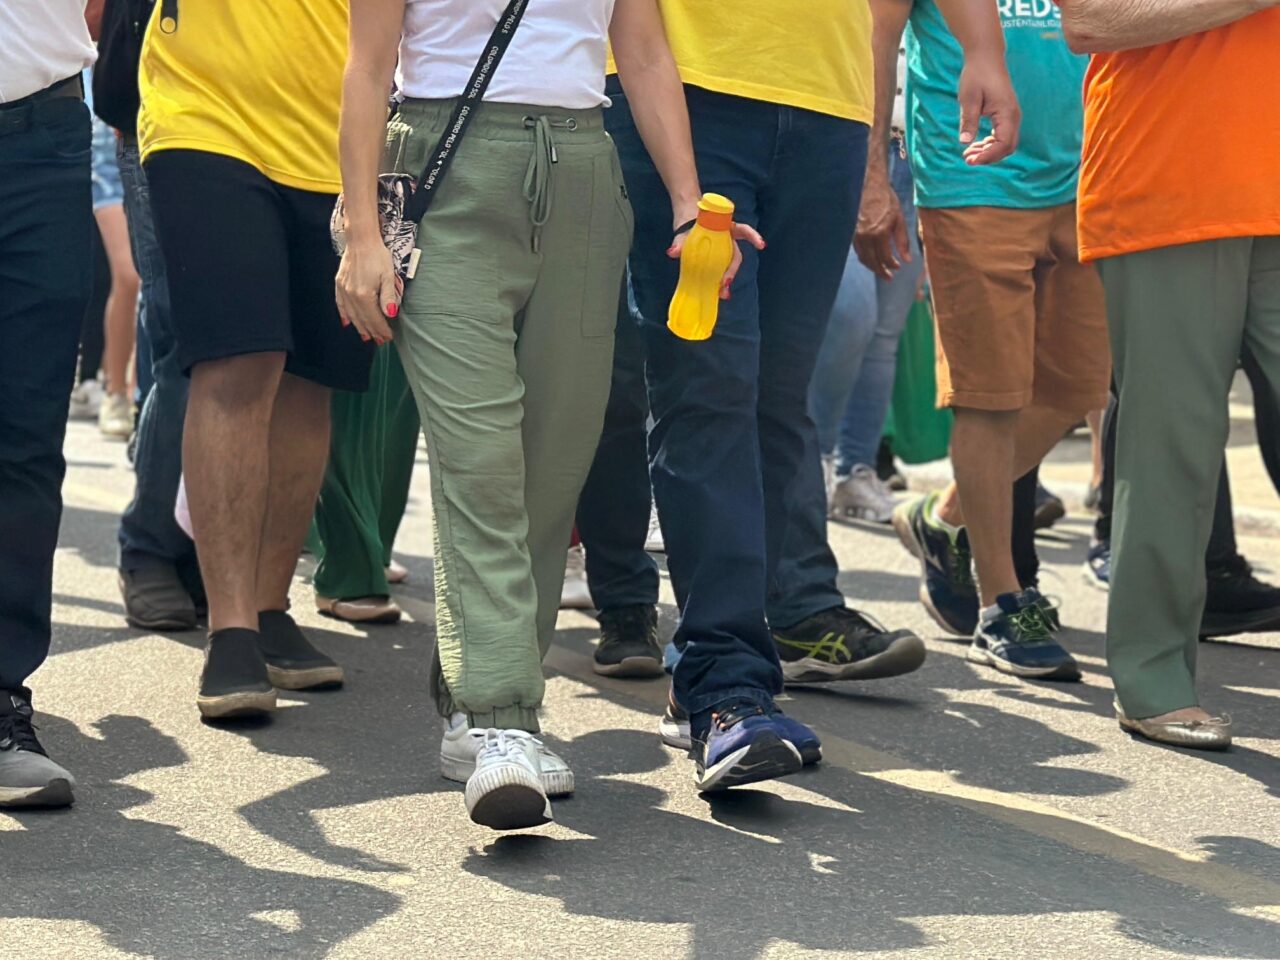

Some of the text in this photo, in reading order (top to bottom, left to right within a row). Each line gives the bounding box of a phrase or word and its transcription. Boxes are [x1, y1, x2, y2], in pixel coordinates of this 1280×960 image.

[466, 86, 479, 100] SOL
[451, 104, 470, 134] COLORIDO
[443, 132, 456, 149] PELO
